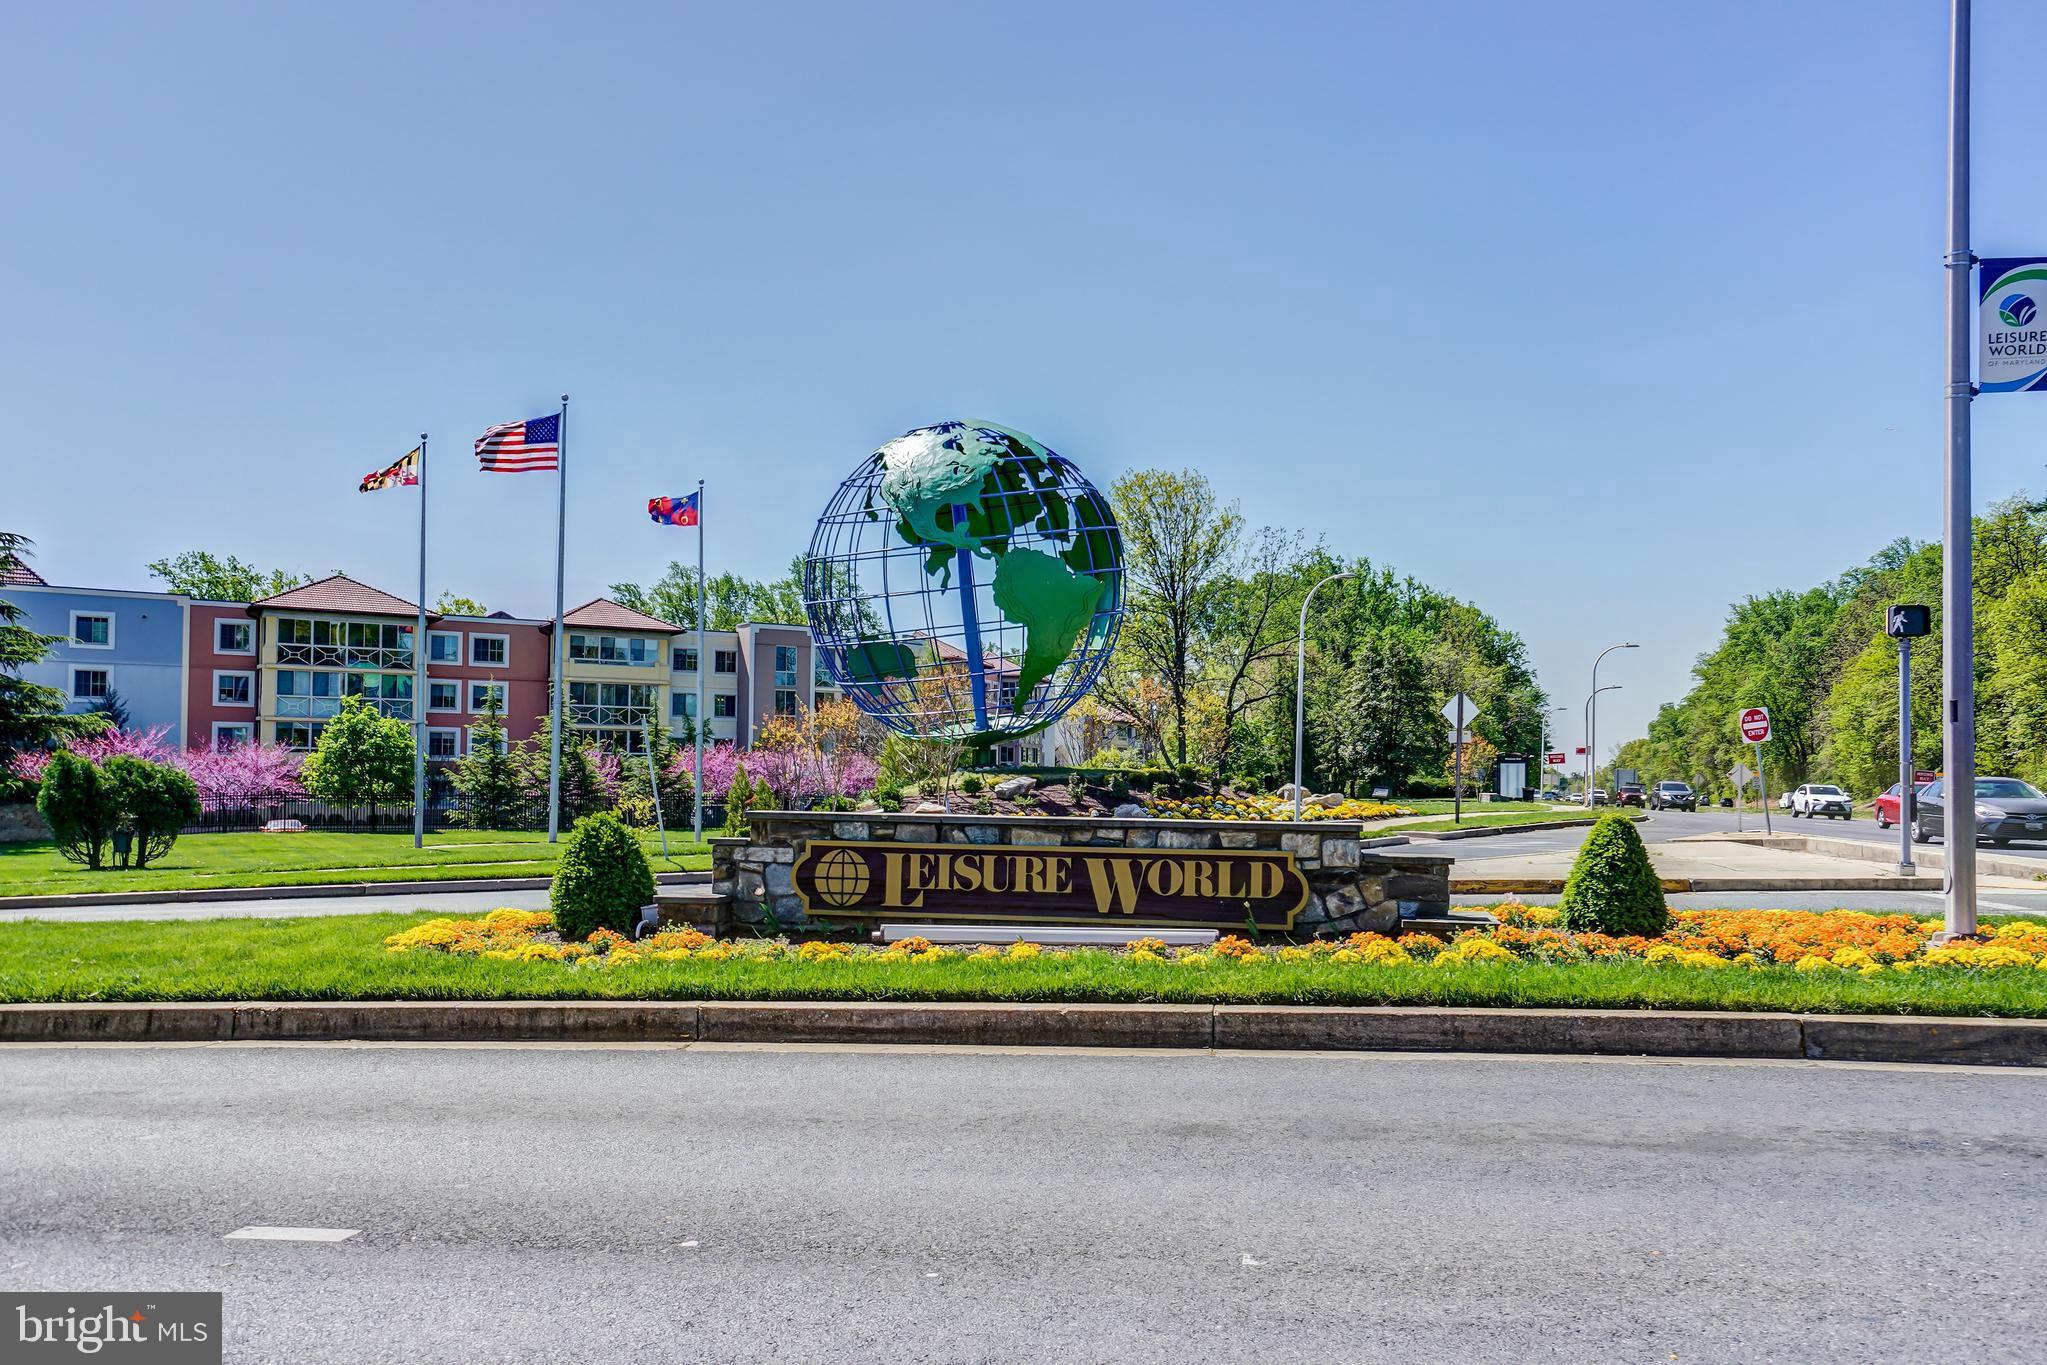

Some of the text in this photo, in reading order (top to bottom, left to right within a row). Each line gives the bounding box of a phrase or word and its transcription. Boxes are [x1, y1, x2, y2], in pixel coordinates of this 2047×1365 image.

[1988, 331, 2047, 344] LEISURE
[1988, 344, 2046, 356] WORLD
[2002, 358, 2046, 366] MARYLAND
[880, 852, 1285, 914] LEISURE WORLD
